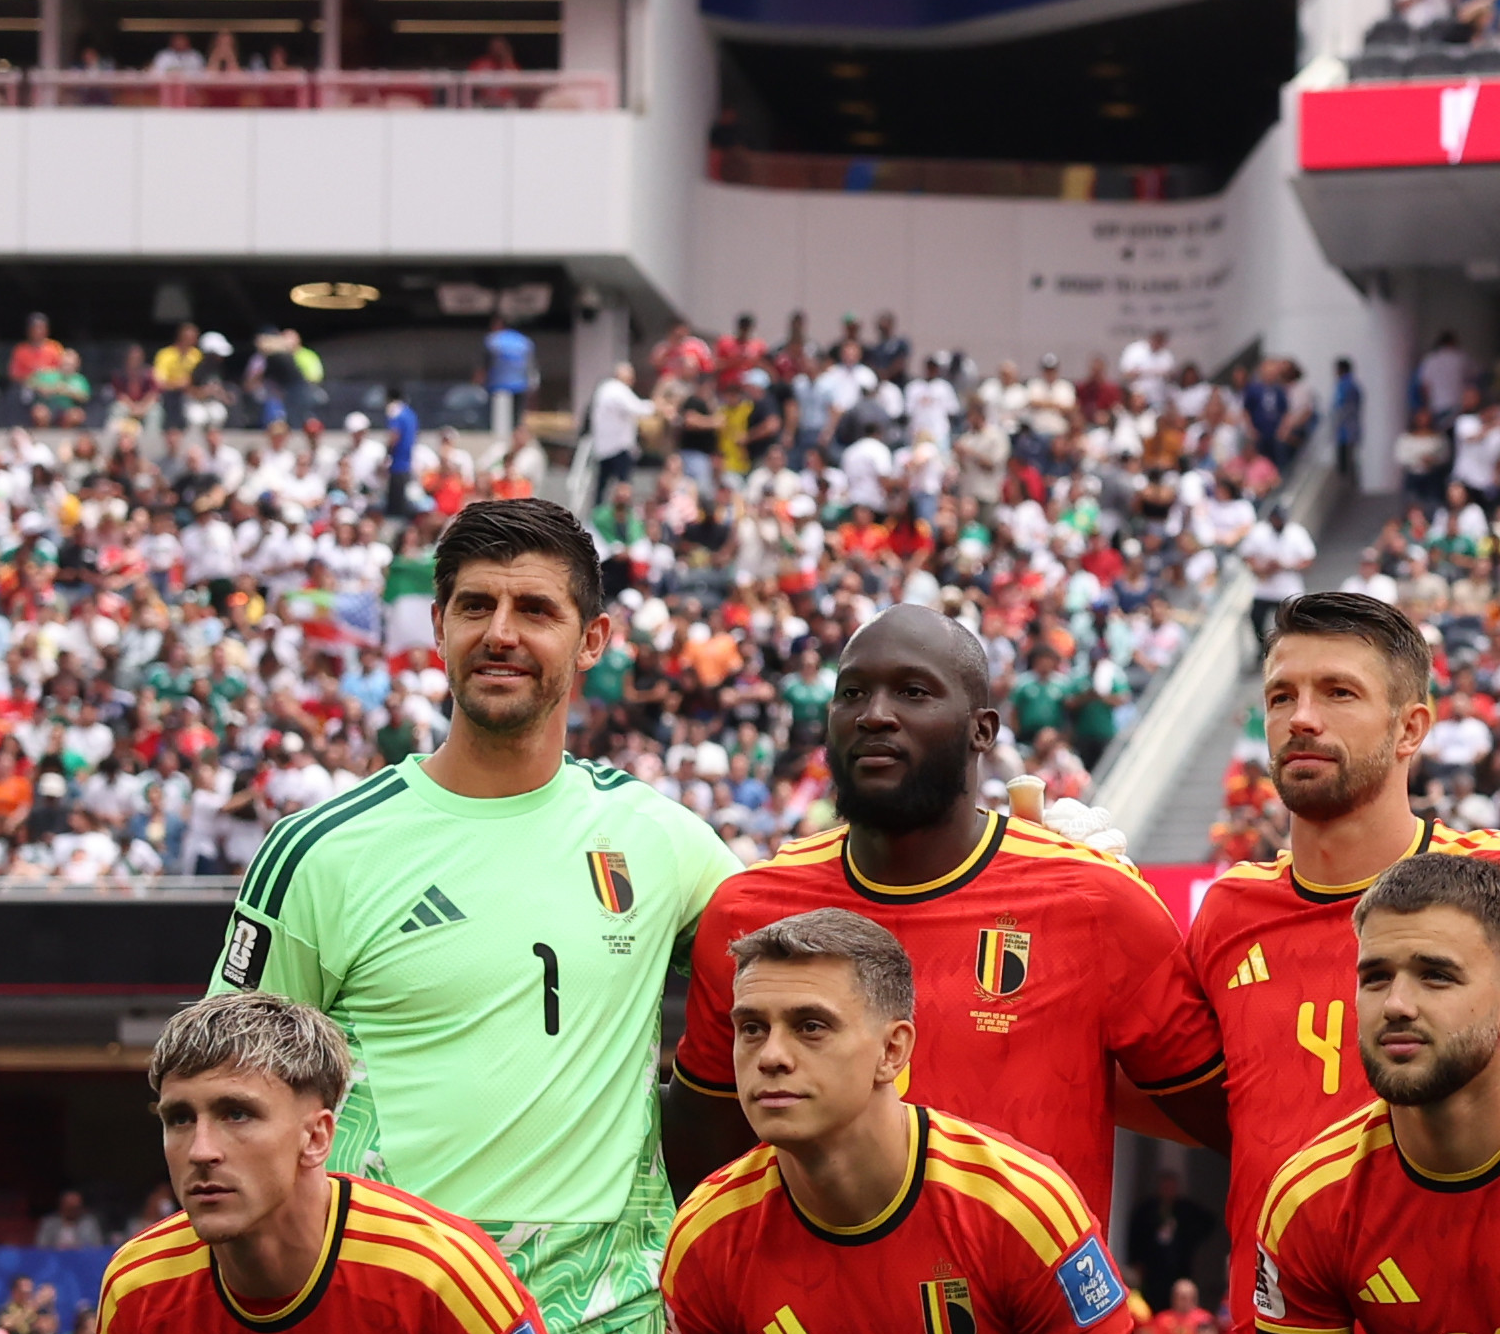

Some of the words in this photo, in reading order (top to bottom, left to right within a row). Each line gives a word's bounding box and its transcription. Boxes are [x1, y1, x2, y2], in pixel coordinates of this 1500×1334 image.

[533, 942, 560, 1037] 1
[1297, 1000, 1345, 1095] 4
[1084, 1281, 1110, 1306] PEACE
